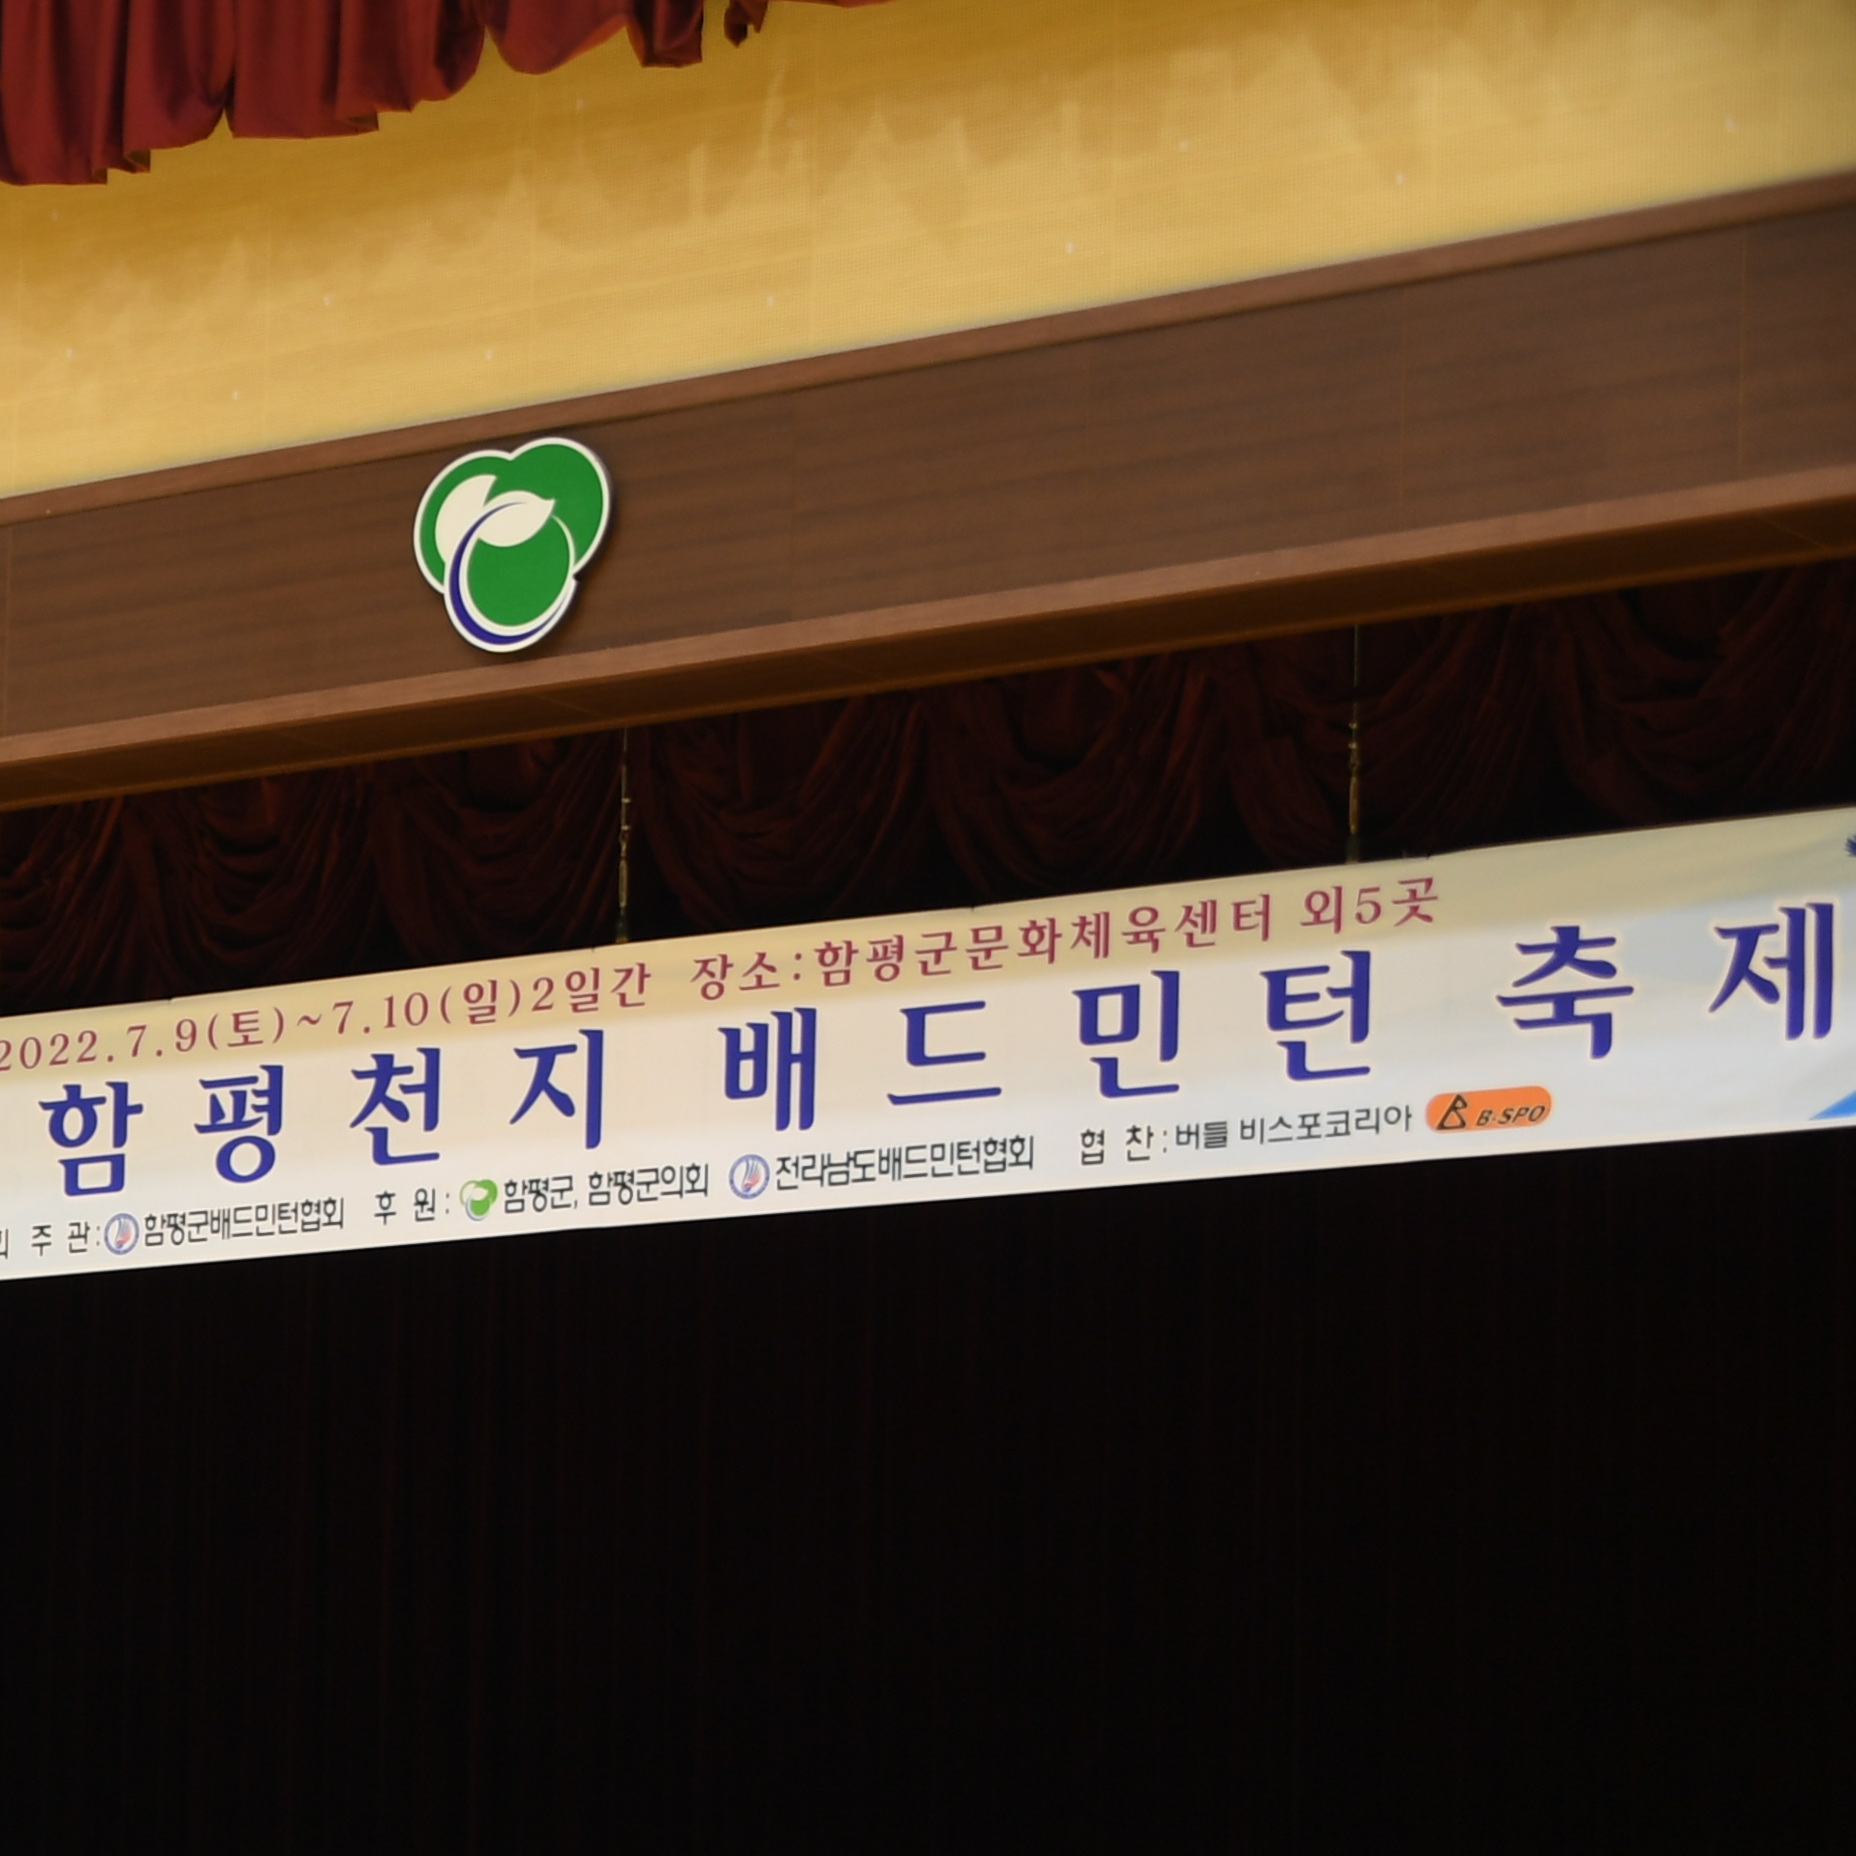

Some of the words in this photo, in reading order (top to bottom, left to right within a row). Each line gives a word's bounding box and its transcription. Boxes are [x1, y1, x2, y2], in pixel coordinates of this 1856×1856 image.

[1300, 876, 1439, 935] 외5곳
[716, 949, 1372, 1132] 배드민턴
[1495, 901, 1835, 1059] 축제
[144, 1197, 345, 1248] 함평군배드민턴협회
[588, 1163, 710, 1208] 함평군의회
[775, 1134, 1035, 1191] 전라남도배드민턴협회
[1240, 1103, 1412, 1145] 비스포코리아
